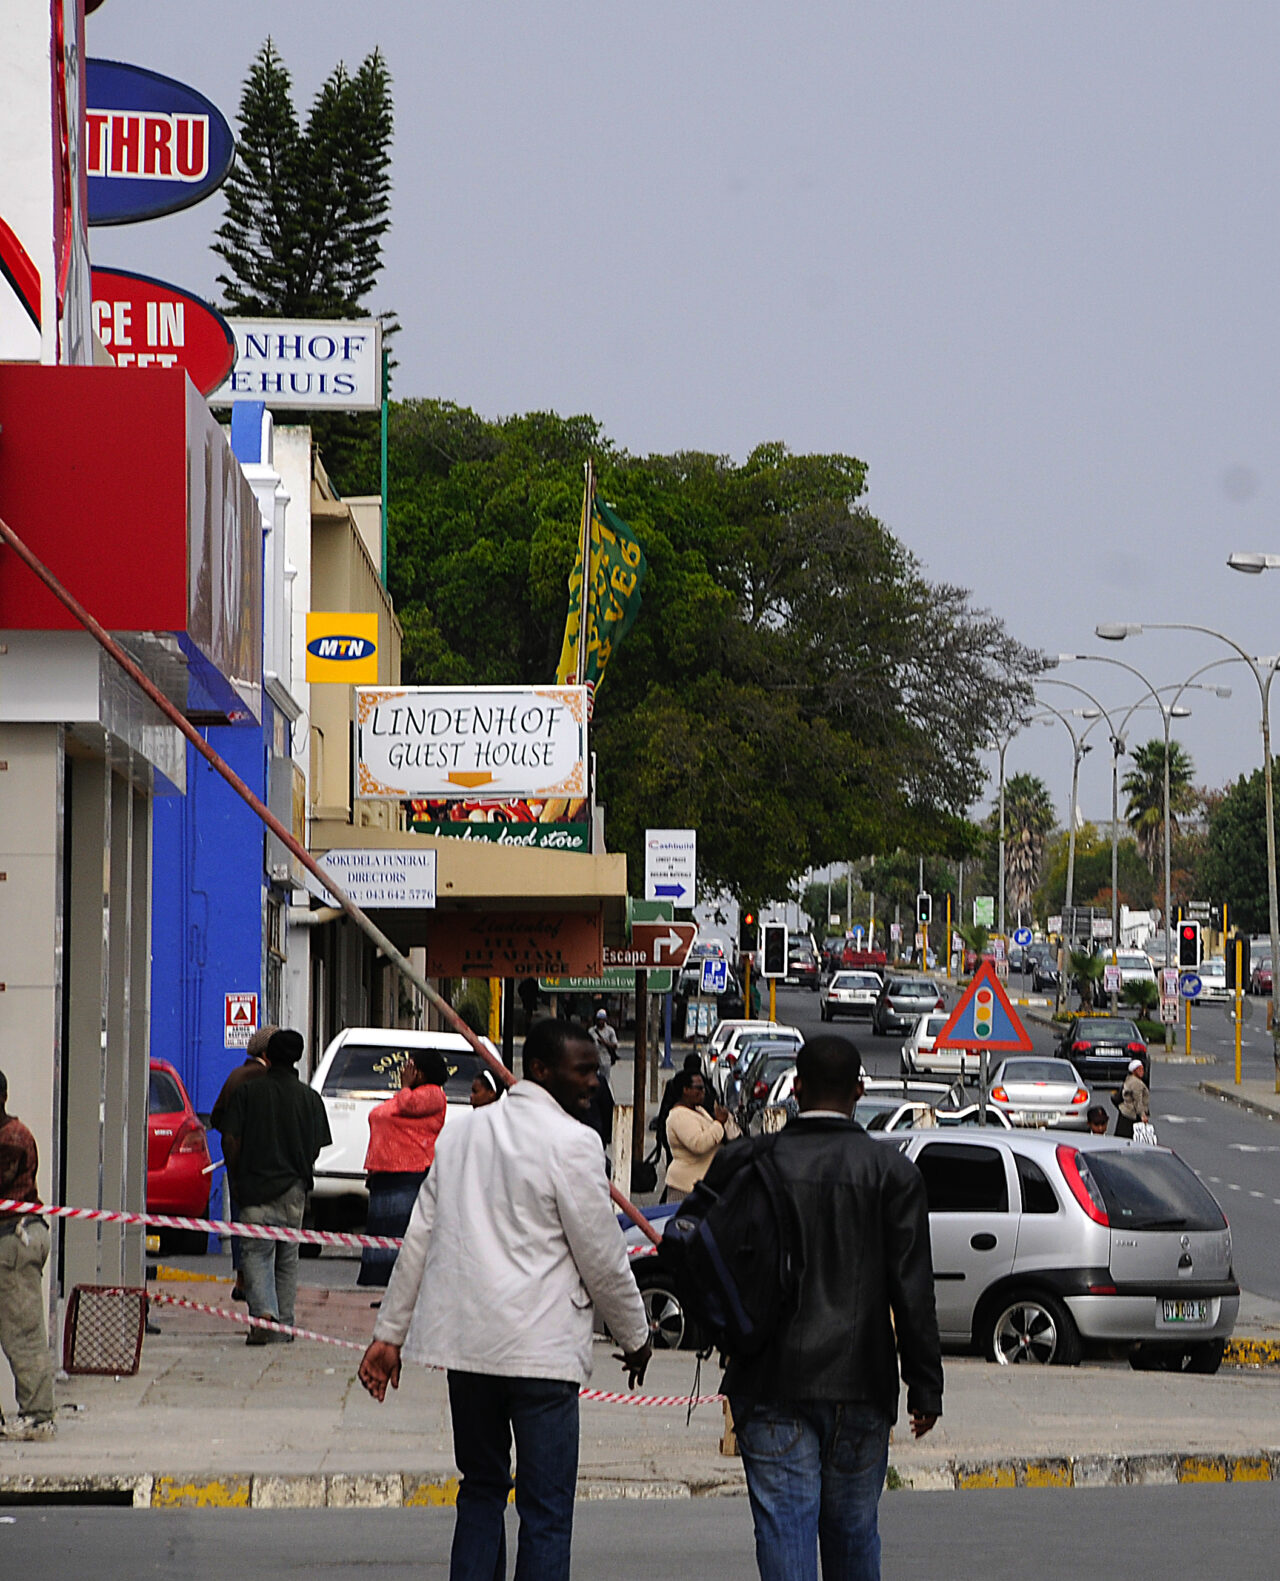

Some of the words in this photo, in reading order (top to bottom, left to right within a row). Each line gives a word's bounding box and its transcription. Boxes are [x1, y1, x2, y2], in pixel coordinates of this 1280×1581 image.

[86, 111, 207, 180] THRU
[147, 301, 185, 347] IN
[245, 334, 366, 362] NHOF
[230, 371, 357, 395] EHUIS
[318, 639, 364, 657] MTN
[371, 706, 564, 737] LINDENHOF
[388, 741, 466, 770] GUEST
[475, 740, 556, 768] HOUSE
[540, 830, 583, 849] store
[326, 855, 381, 867] SOKUDELA
[383, 855, 430, 867] FUNERAL
[347, 871, 407, 883] DIRECTORS
[602, 949, 647, 967] Escape
